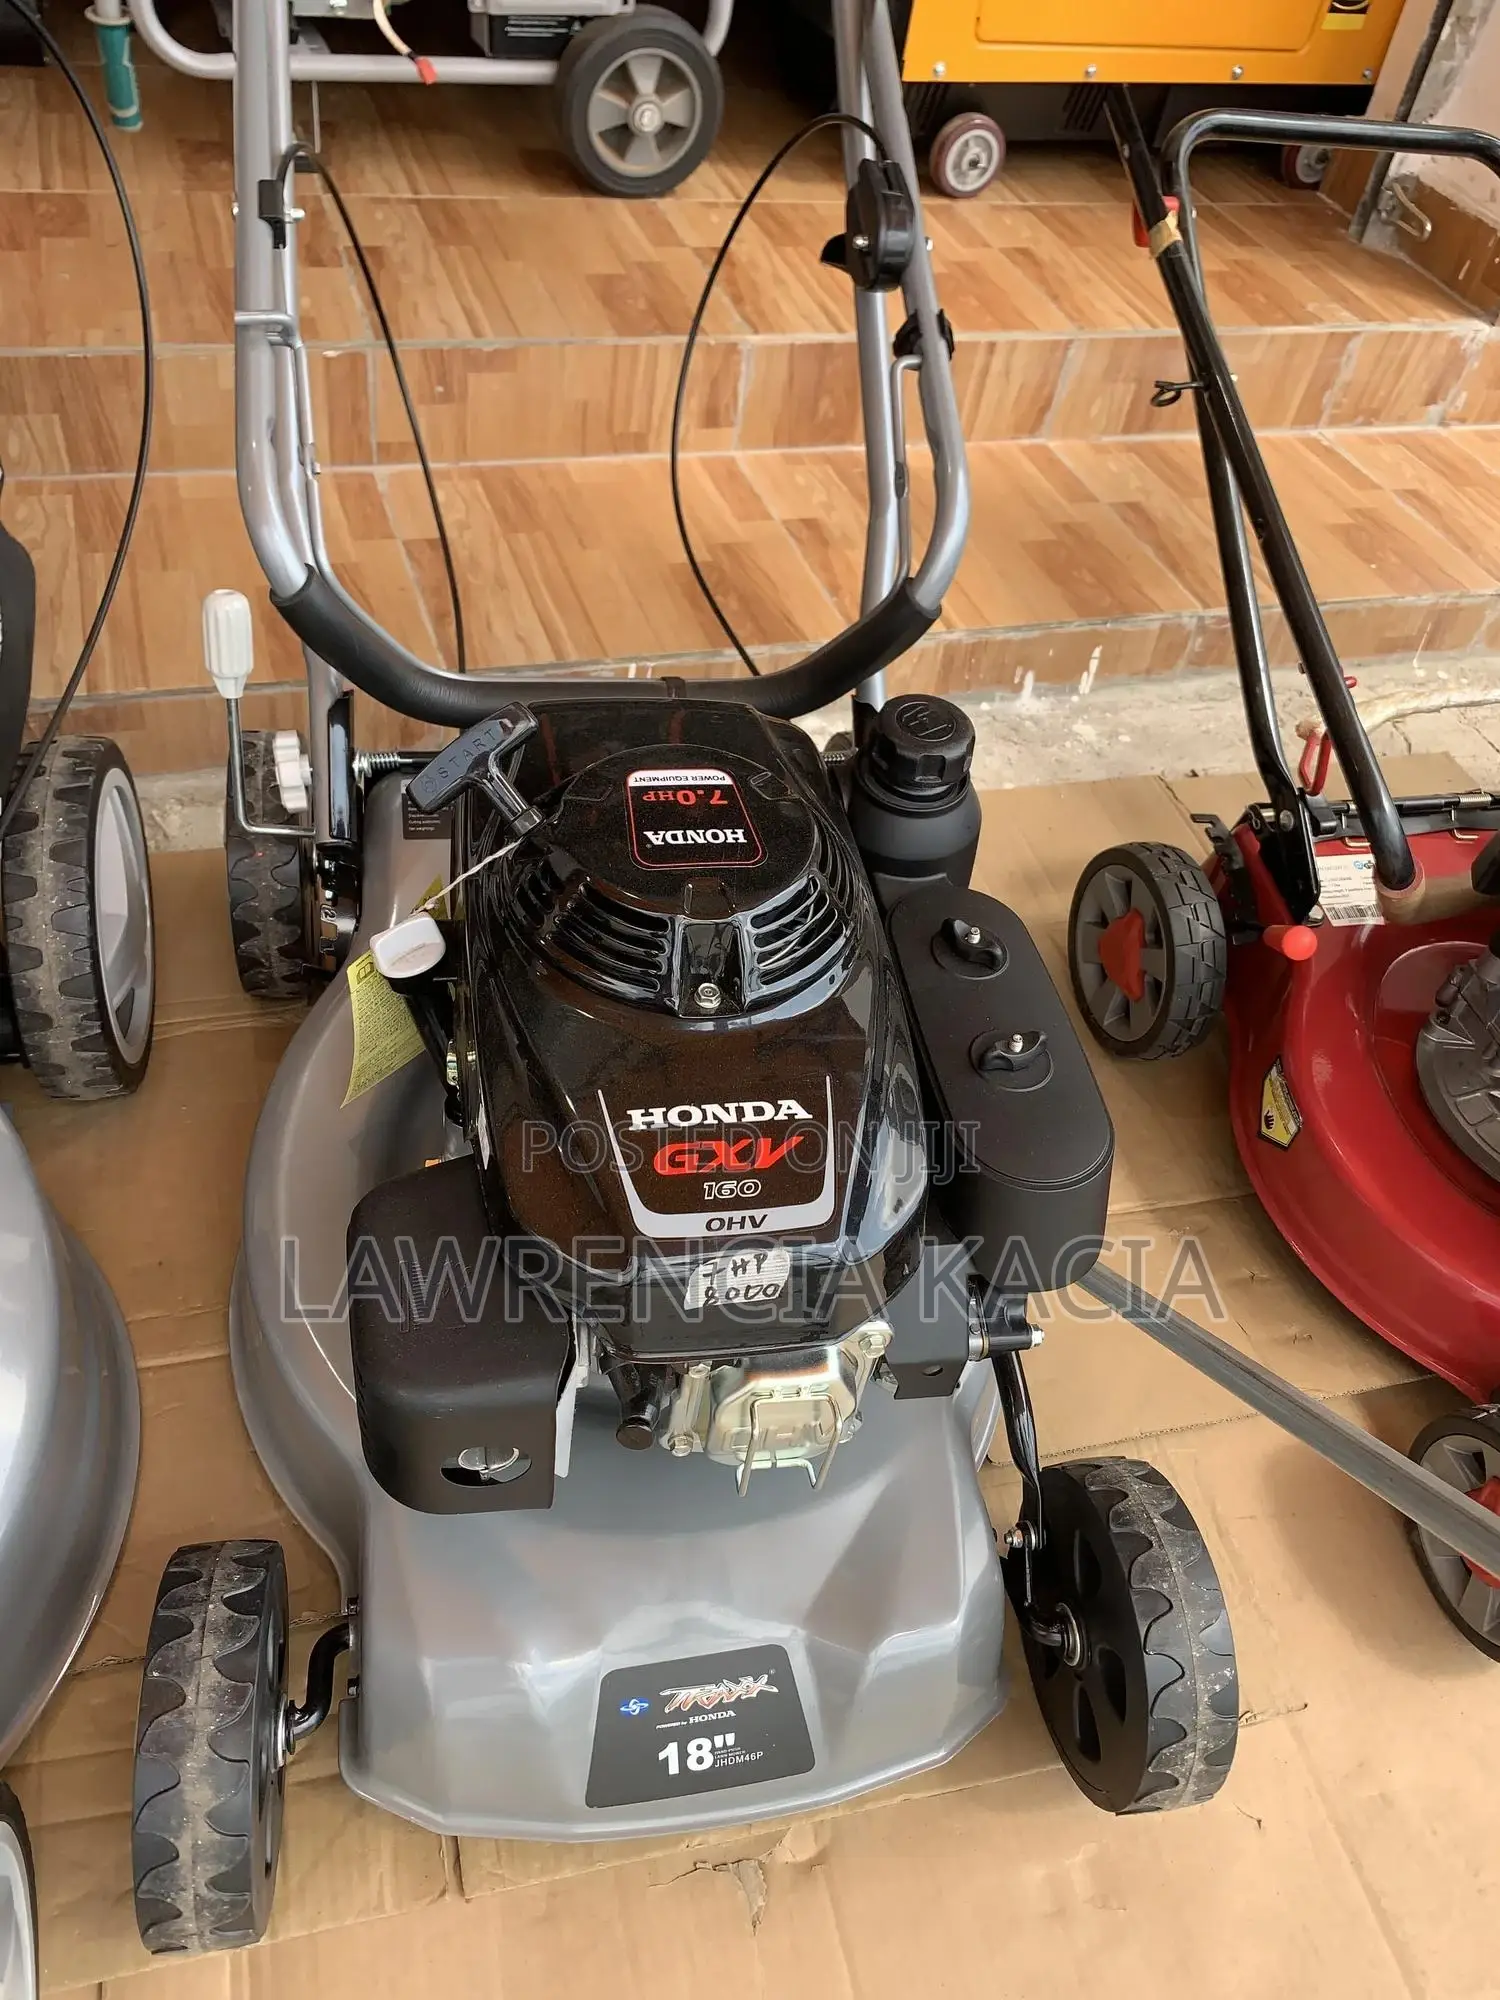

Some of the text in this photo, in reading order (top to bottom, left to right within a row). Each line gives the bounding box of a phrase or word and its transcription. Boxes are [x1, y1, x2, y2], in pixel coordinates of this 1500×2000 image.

[437, 728, 498, 780] START
[633, 775, 690, 783] EQUIPMENT
[643, 828, 748, 846] HONDA
[626, 1099, 814, 1131] HONDA
[653, 1136, 805, 1176] GXV
[703, 1178, 762, 1200] 160
[705, 1213, 769, 1232] OHV
[688, 1710, 737, 1724] HONDA
[714, 1751, 764, 1768] JHDM46P
